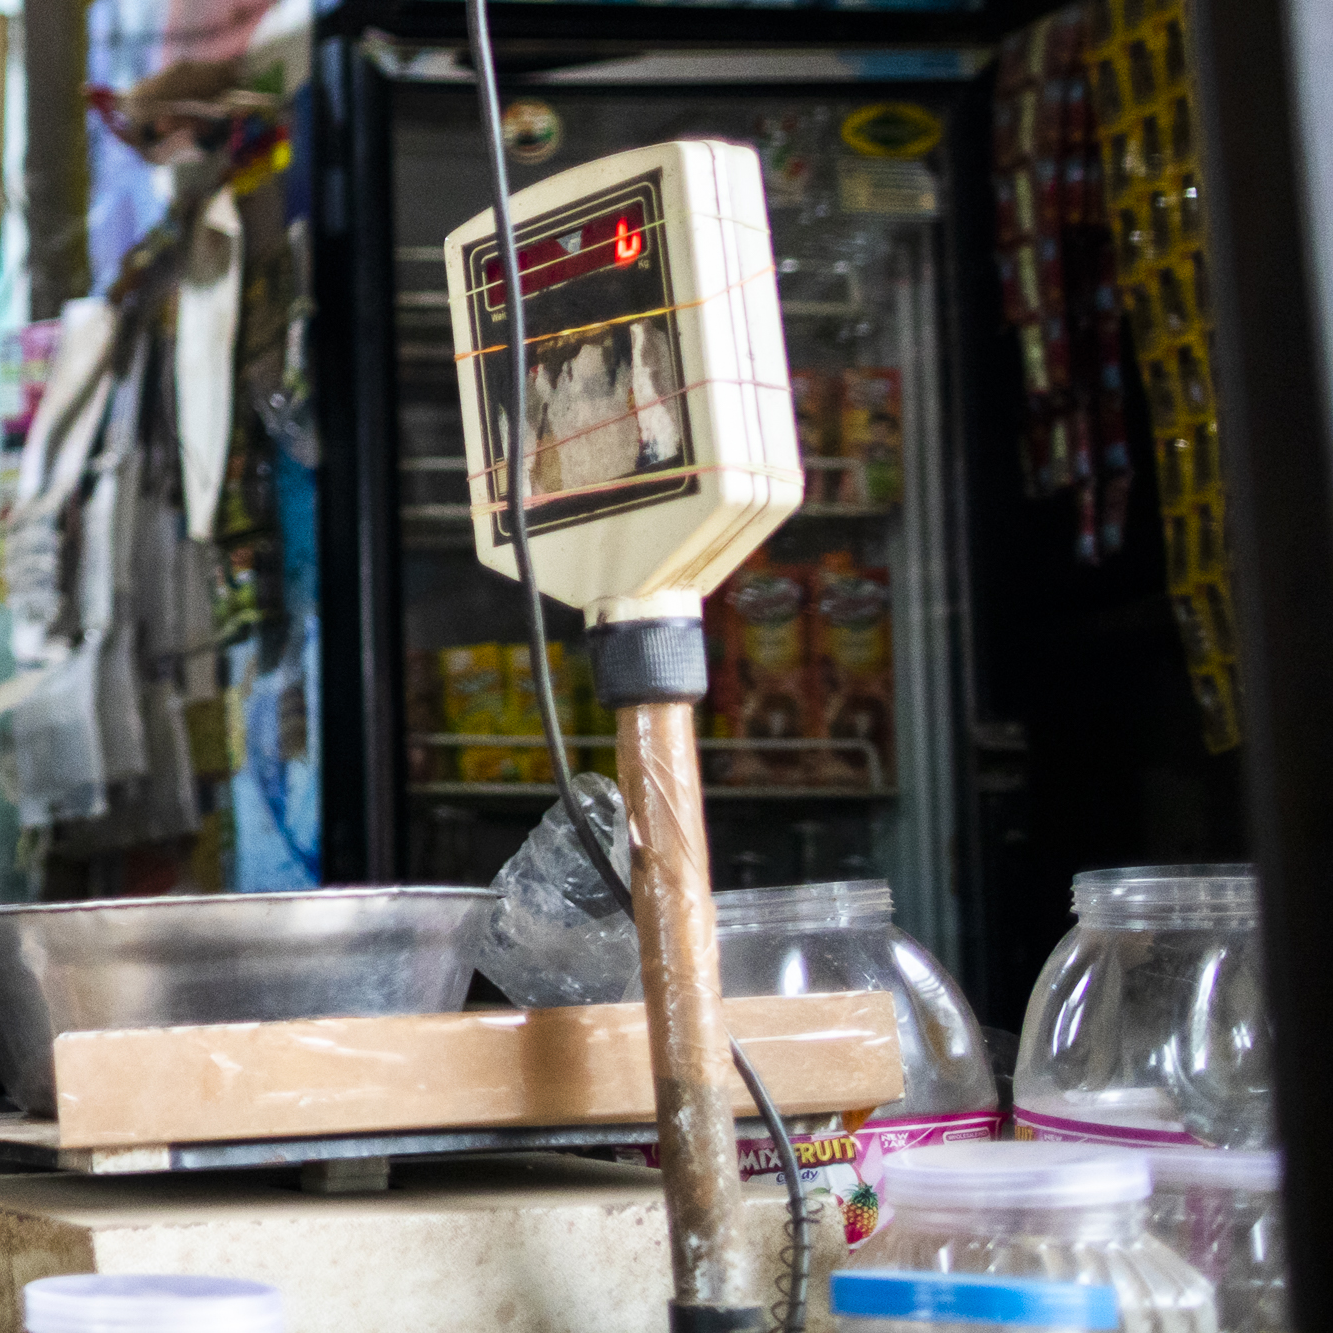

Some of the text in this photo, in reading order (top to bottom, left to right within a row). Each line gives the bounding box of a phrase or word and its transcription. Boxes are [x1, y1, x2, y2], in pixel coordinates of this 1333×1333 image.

[881, 1132, 909, 1142] NEW
[883, 1139, 906, 1150] JAR
[791, 1136, 857, 1165] FRUIT
